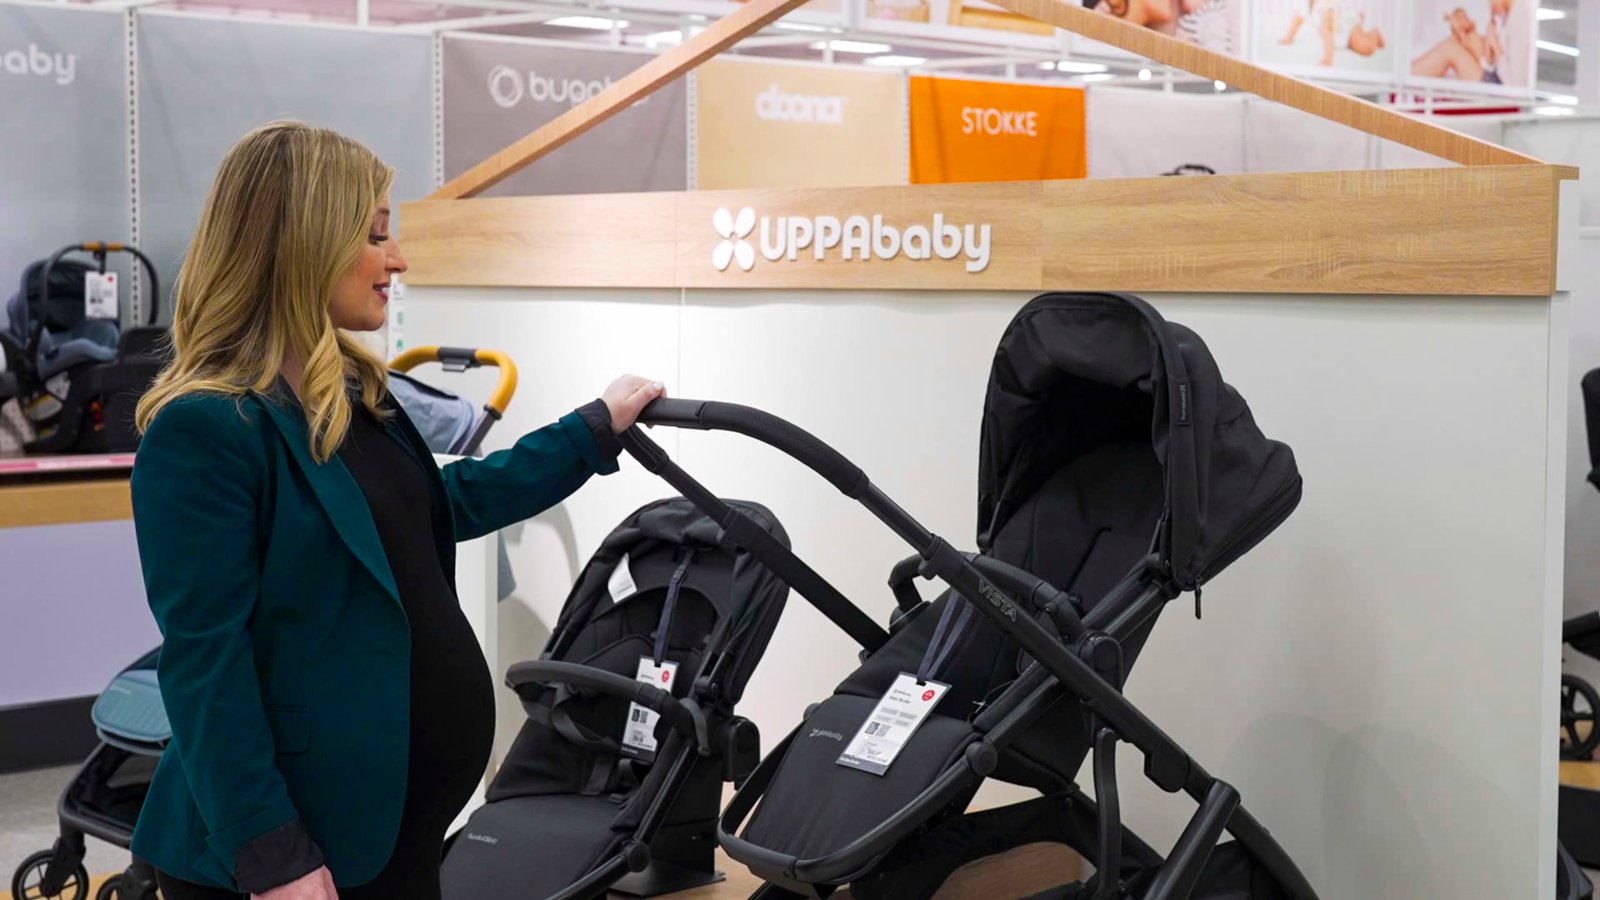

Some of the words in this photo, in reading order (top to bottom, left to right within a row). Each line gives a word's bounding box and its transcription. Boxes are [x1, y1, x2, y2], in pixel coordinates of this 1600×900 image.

[0, 43, 76, 85] aby
[754, 83, 844, 124] doona
[961, 106, 1038, 137] STOKKE
[760, 213, 991, 273] UPPAbaby
[979, 579, 1017, 622] VISTA
